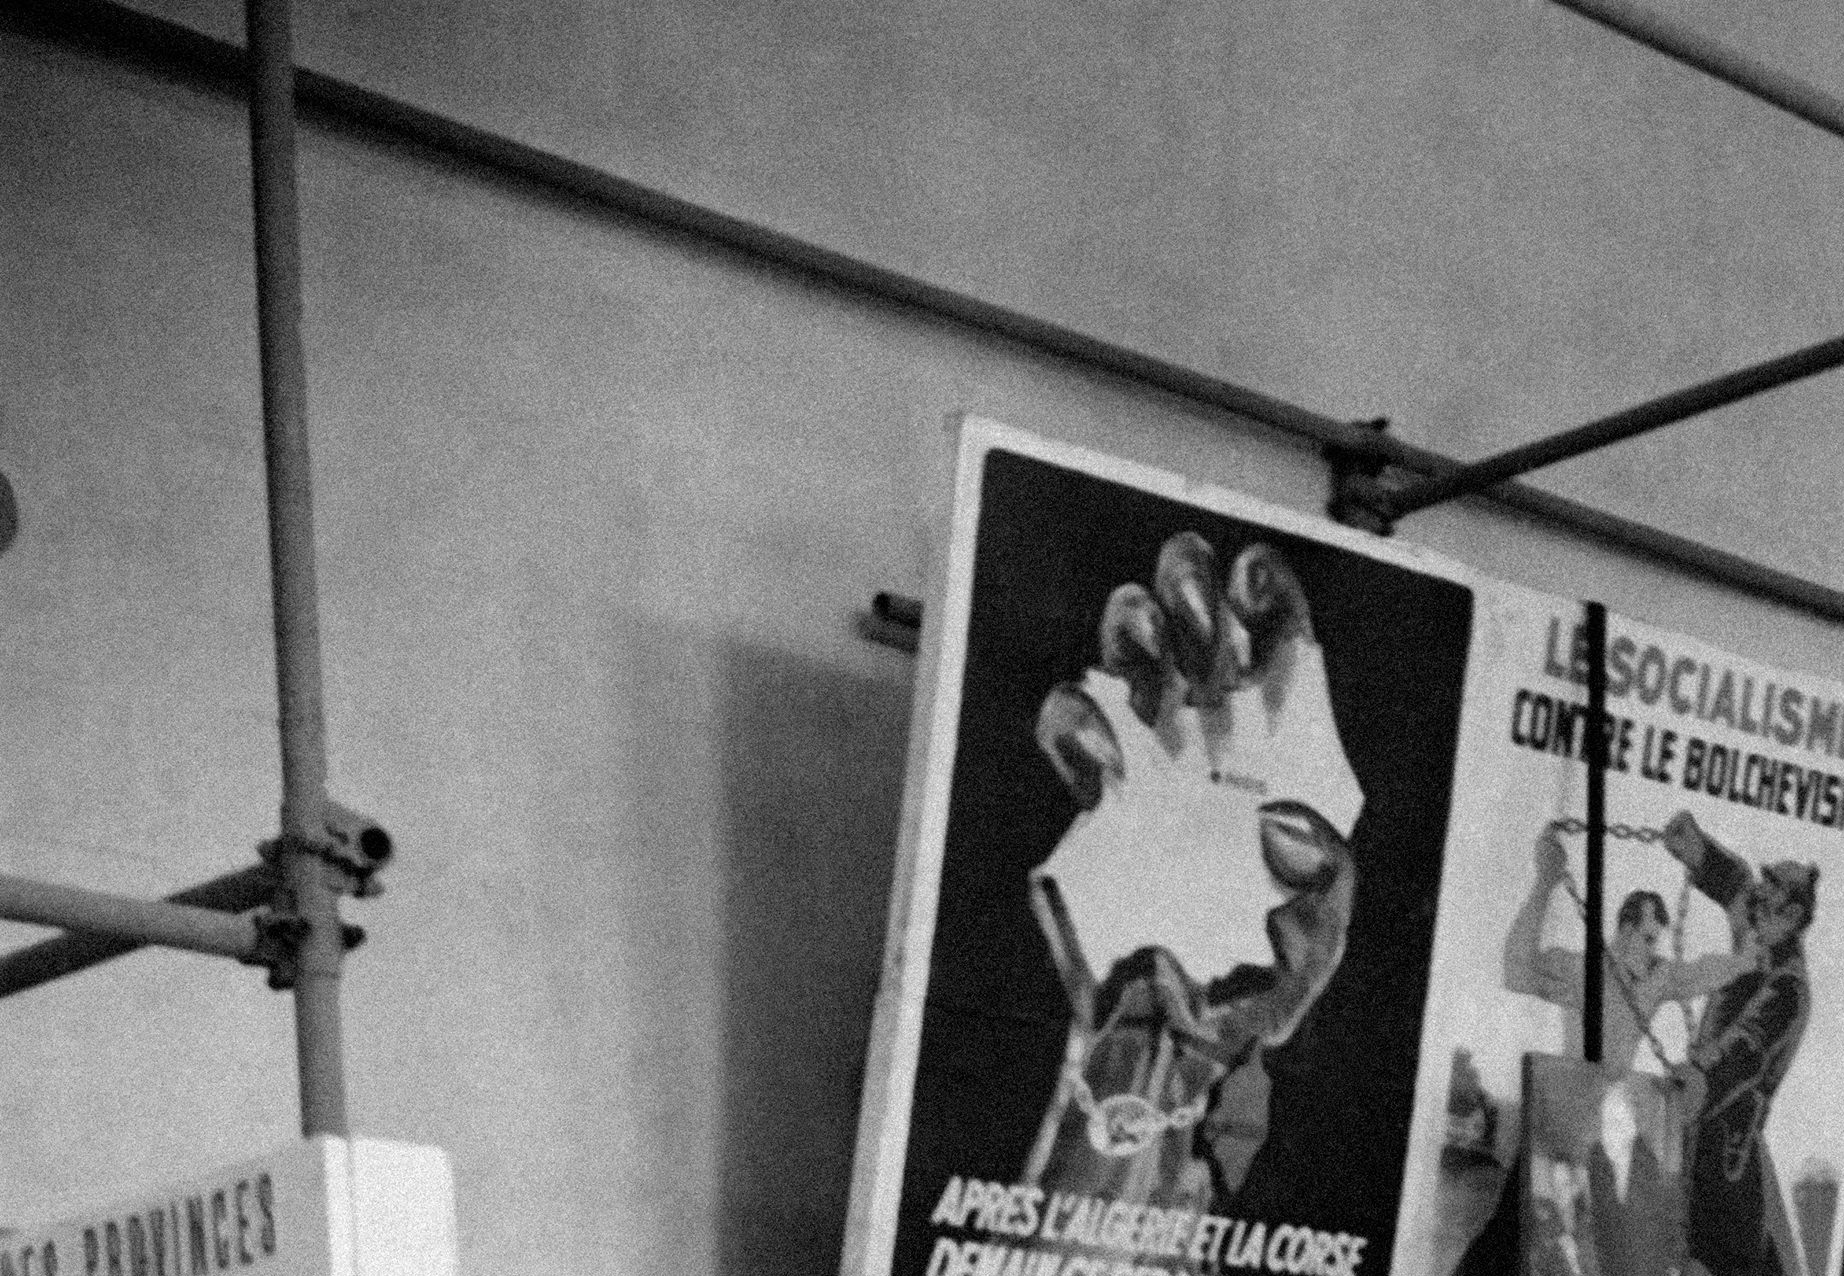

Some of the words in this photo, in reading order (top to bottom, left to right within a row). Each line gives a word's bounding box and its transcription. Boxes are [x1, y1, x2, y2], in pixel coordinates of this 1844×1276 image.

[1640, 723, 1677, 783] LE
[1041, 1193, 1195, 1259] L'ALGERIE
[1189, 1213, 1234, 1261] ET
[1226, 1218, 1267, 1270] LA
